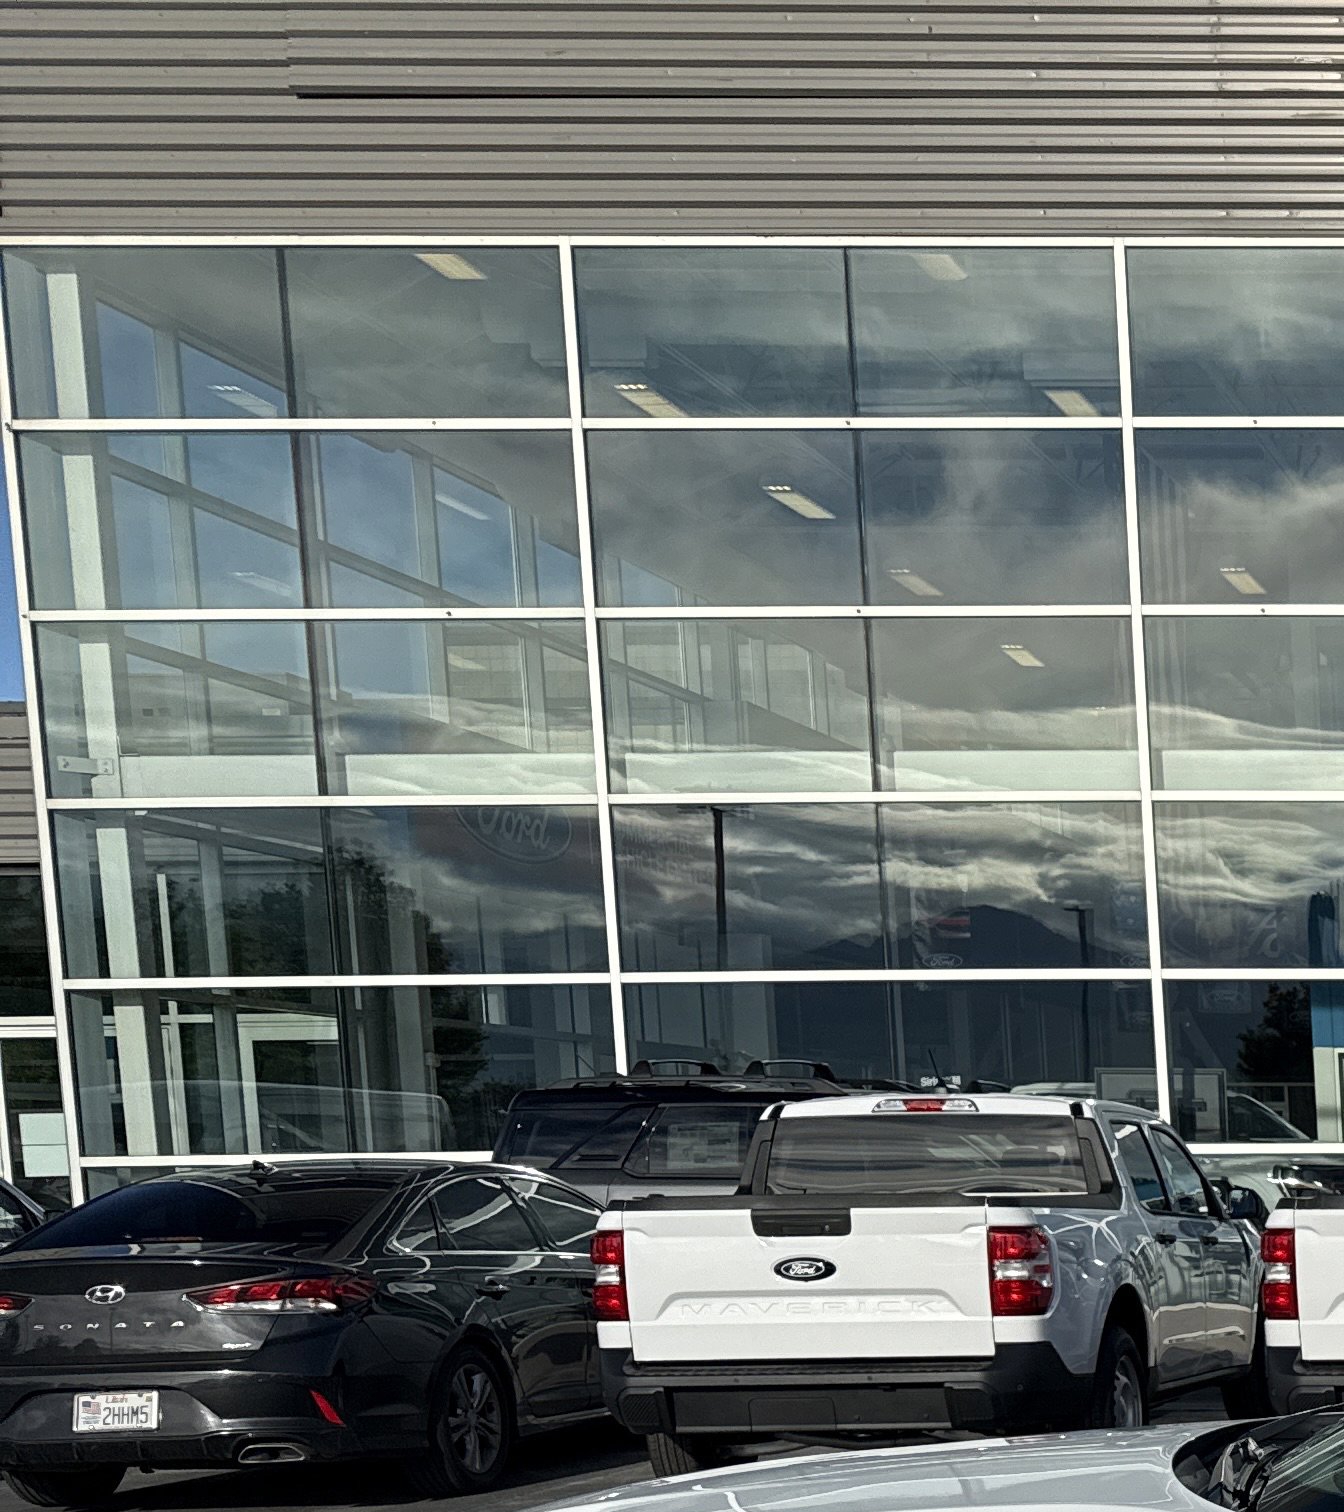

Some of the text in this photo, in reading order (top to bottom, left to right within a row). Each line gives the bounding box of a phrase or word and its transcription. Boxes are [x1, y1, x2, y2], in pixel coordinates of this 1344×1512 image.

[681, 1300, 940, 1316] MAVERICK
[33, 1320, 185, 1331] SONATA
[102, 1405, 149, 1426] 2HHM5
